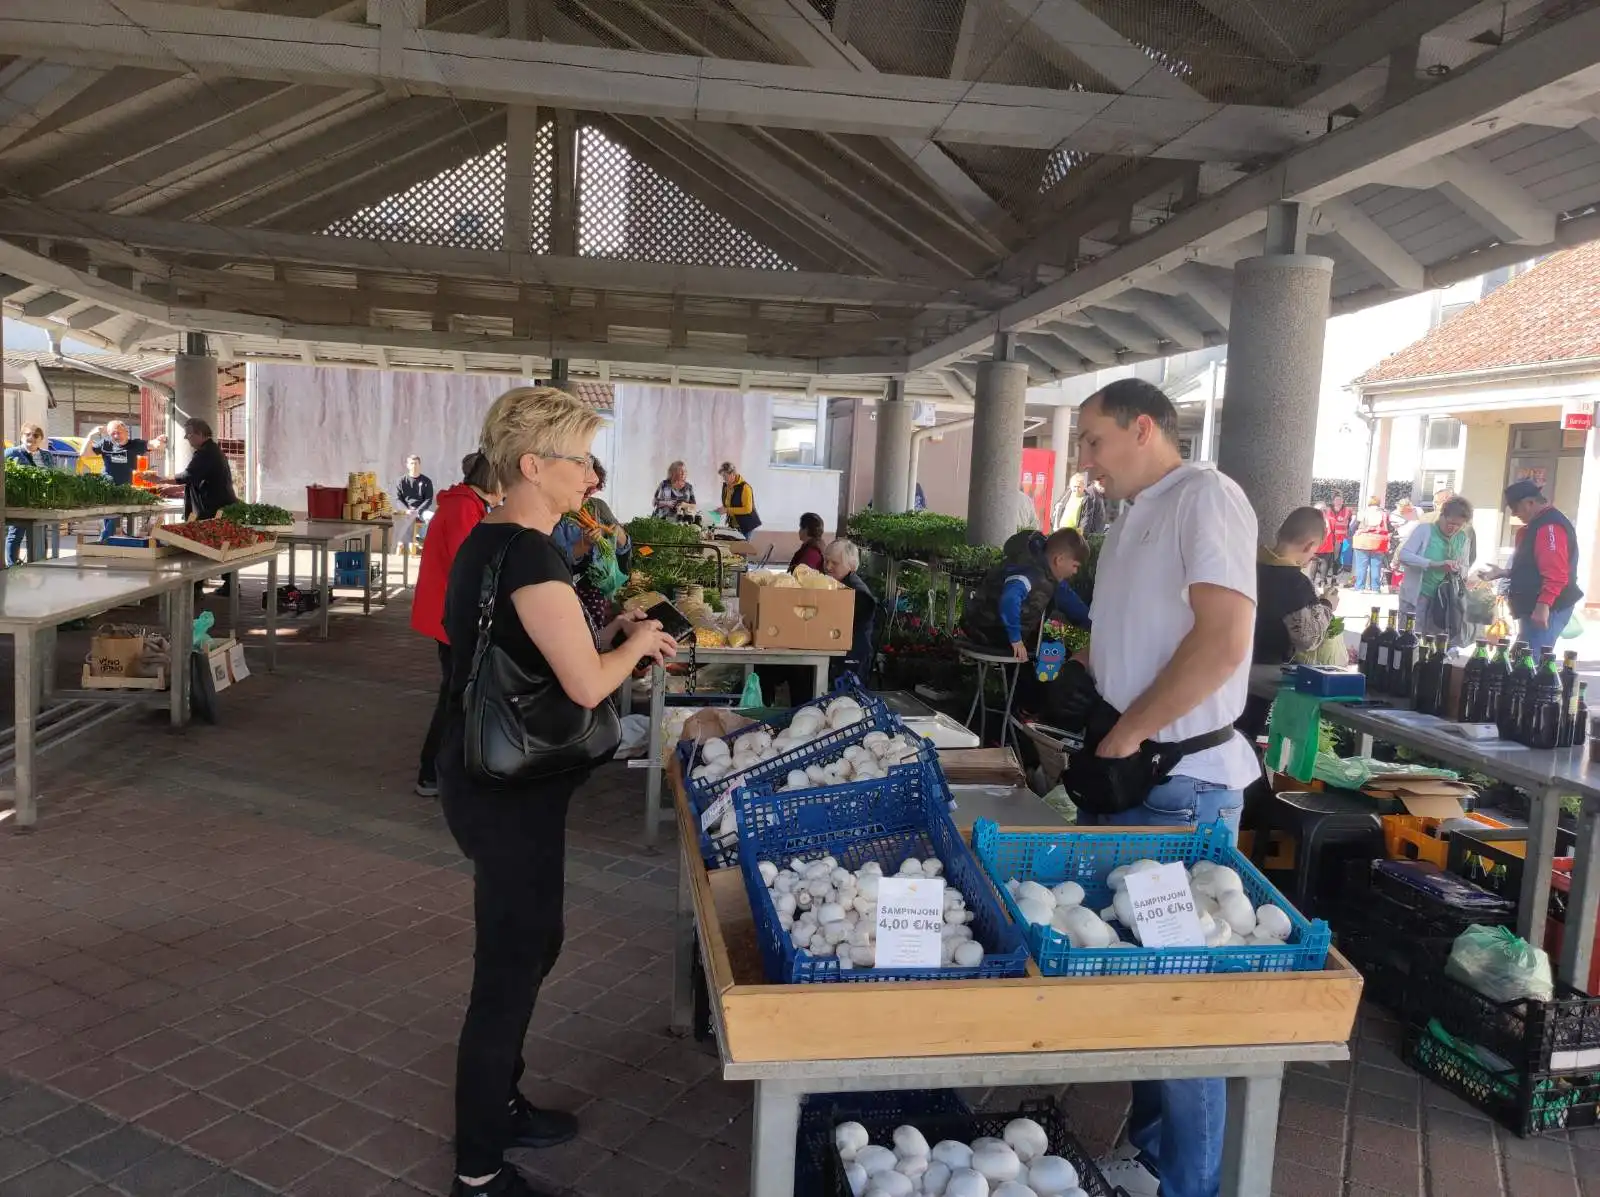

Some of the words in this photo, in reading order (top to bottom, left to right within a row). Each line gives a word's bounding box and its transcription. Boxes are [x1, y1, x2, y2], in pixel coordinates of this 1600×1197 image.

[881, 905, 939, 916] ŠAMPINJONI
[1136, 907, 1164, 924] 4,00
[1167, 901, 1194, 915] €/kg
[879, 918, 909, 931] 4,00
[913, 919, 942, 933] €/kg
